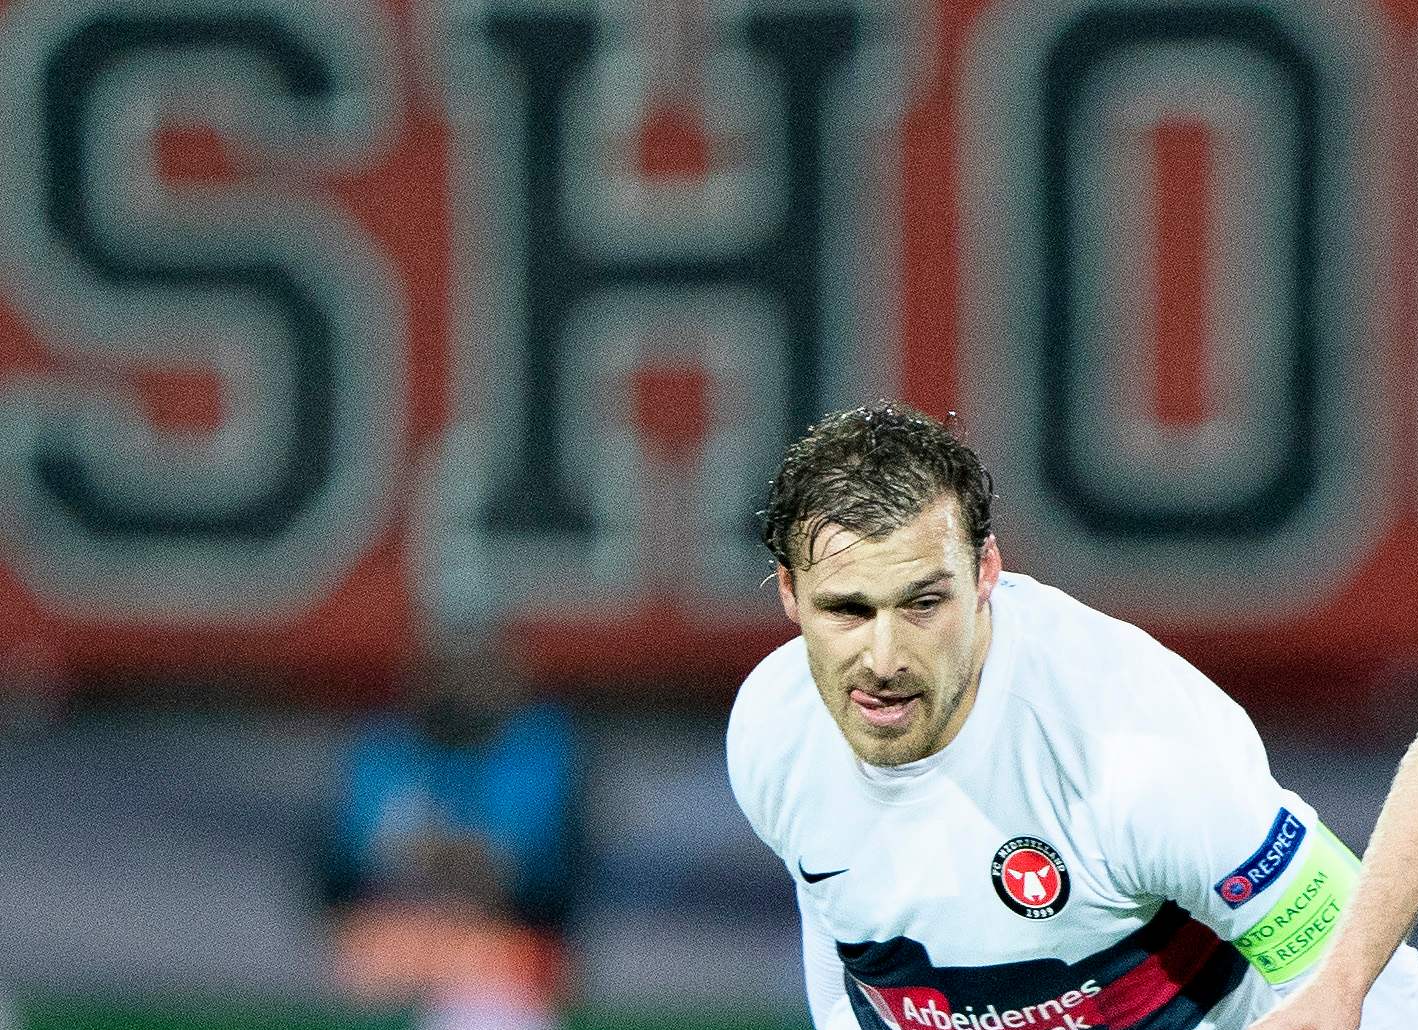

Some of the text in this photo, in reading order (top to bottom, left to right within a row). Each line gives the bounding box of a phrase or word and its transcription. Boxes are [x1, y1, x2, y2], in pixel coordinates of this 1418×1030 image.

[1247, 813, 1301, 884] RESPECT
[1025, 905, 1055, 919] 1999
[1276, 898, 1341, 961] RESPECT
[1248, 924, 1275, 942] TO
